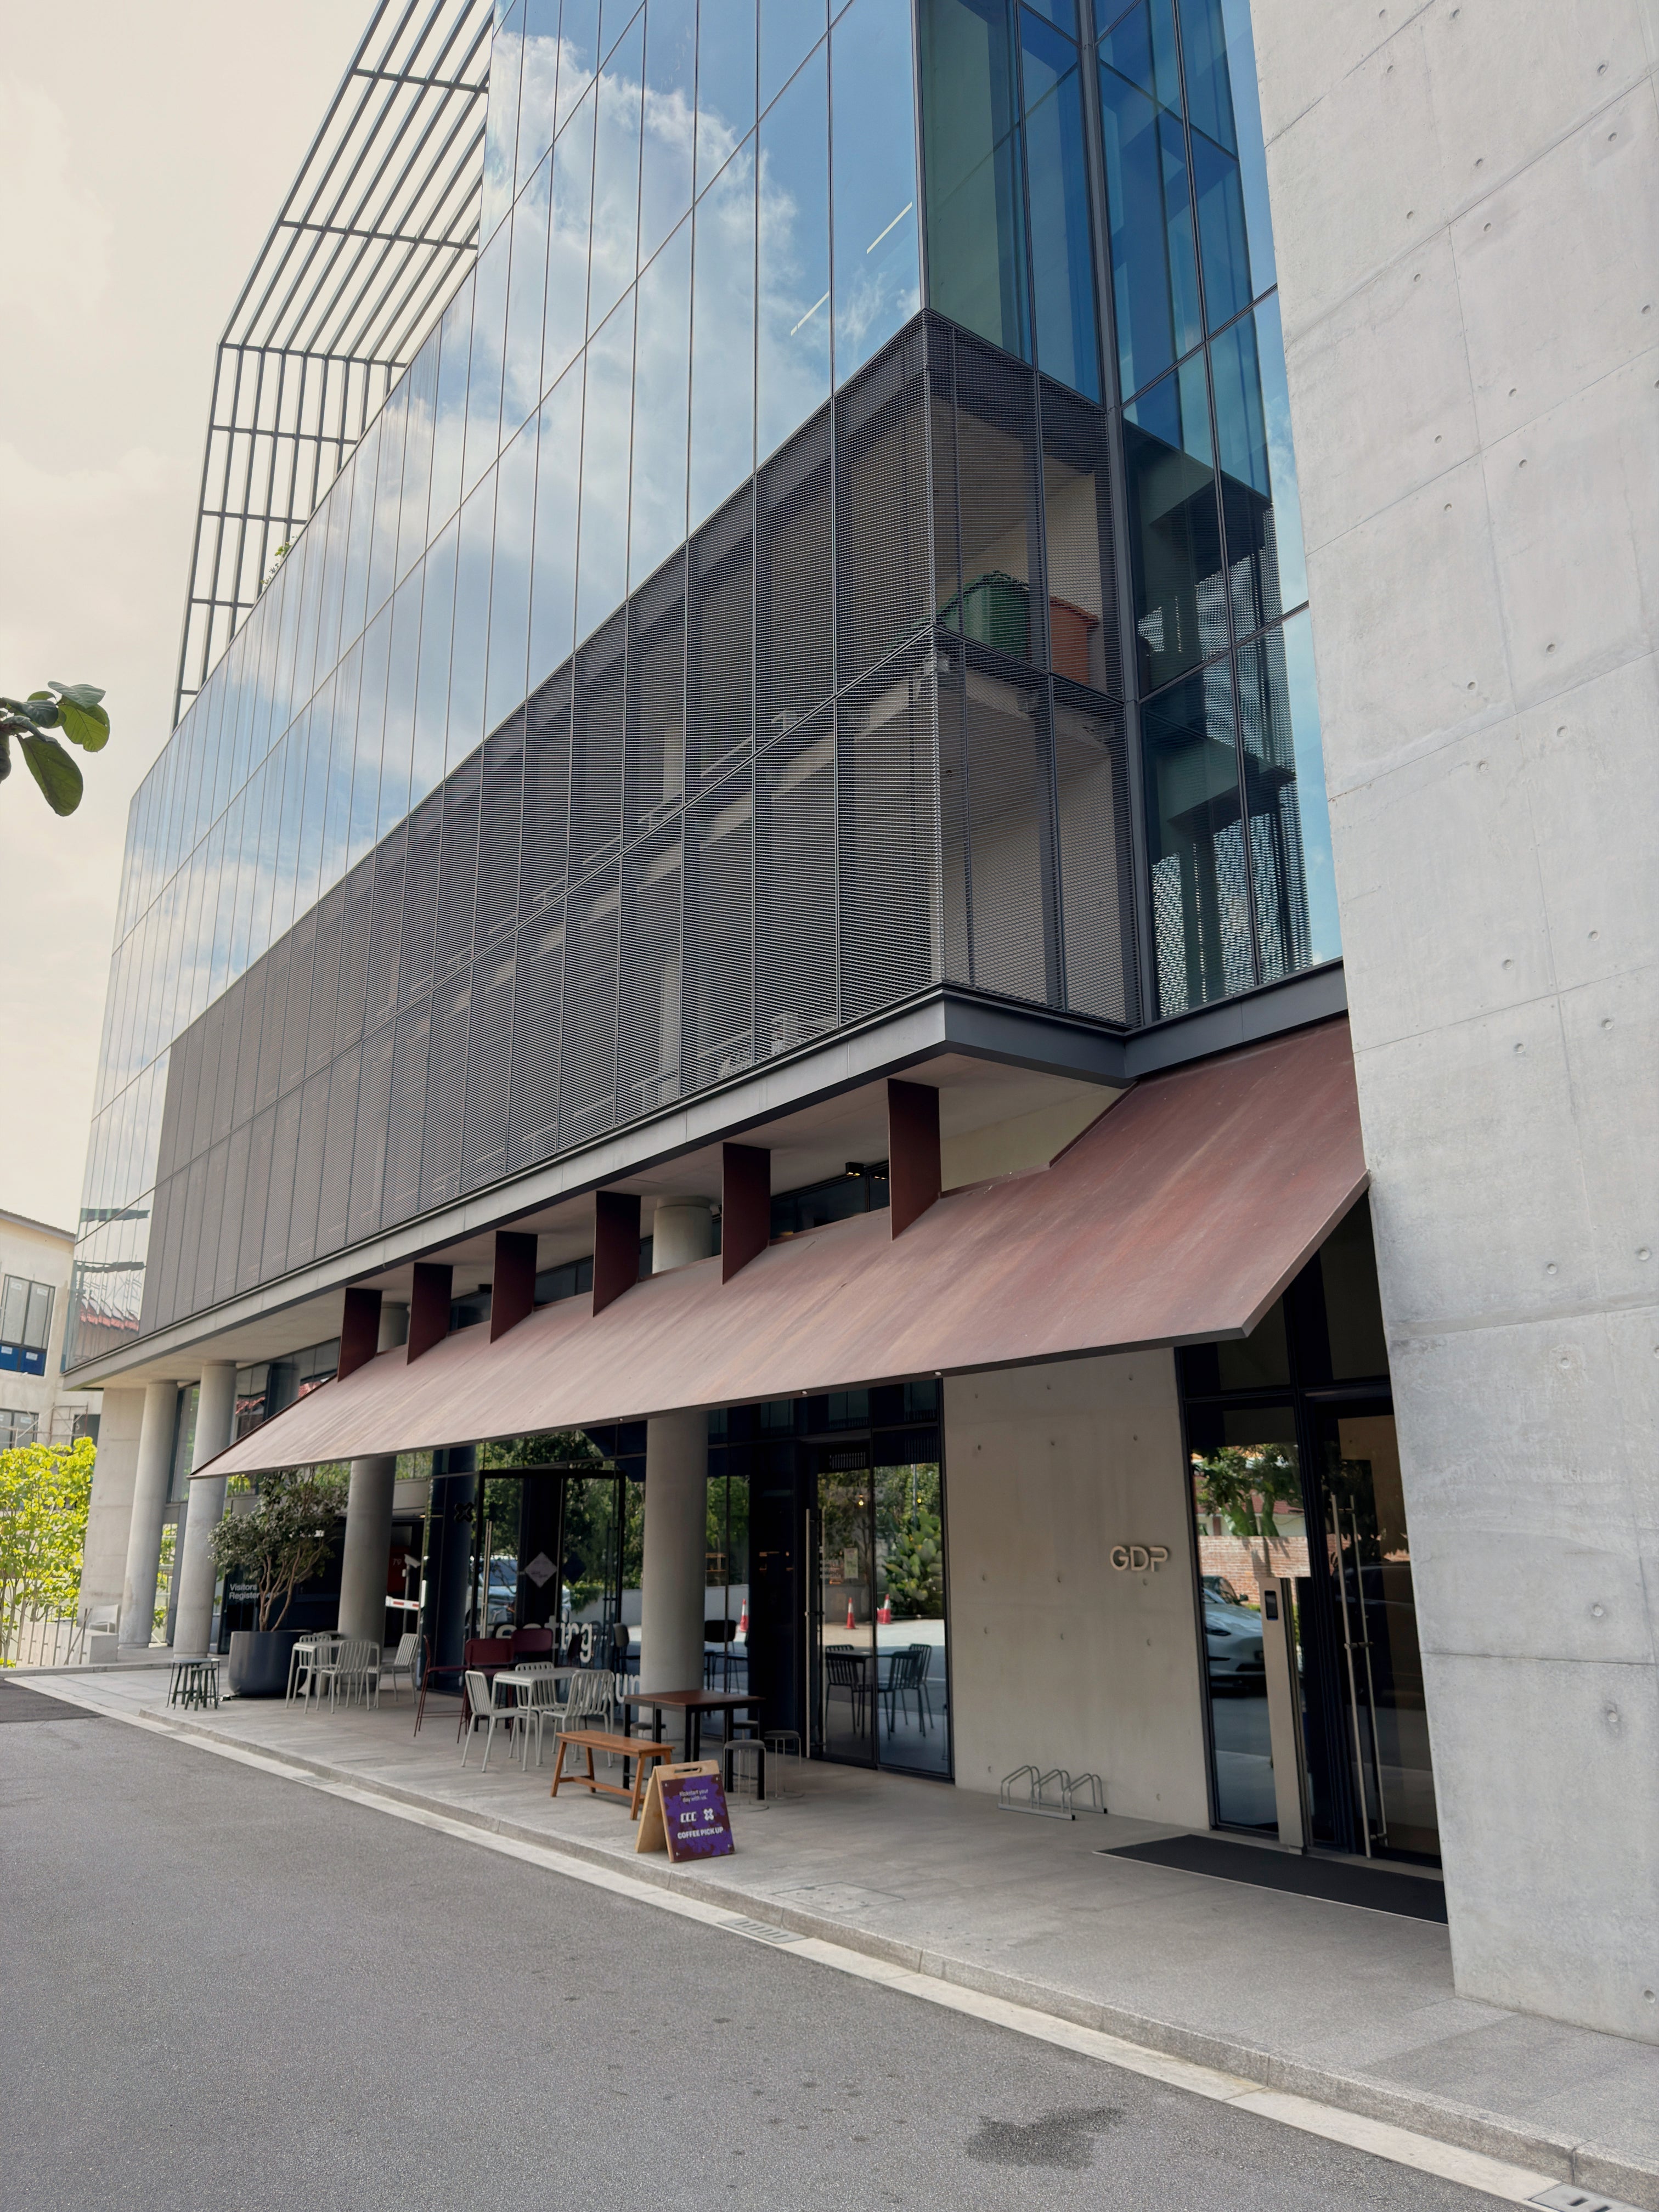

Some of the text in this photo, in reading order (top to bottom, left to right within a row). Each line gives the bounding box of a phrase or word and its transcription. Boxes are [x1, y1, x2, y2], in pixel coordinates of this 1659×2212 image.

[1110, 1545, 1169, 1572] GDP
[229, 1592, 261, 1601] Register
[677, 1826, 724, 1839] COFFEE PICK UP
